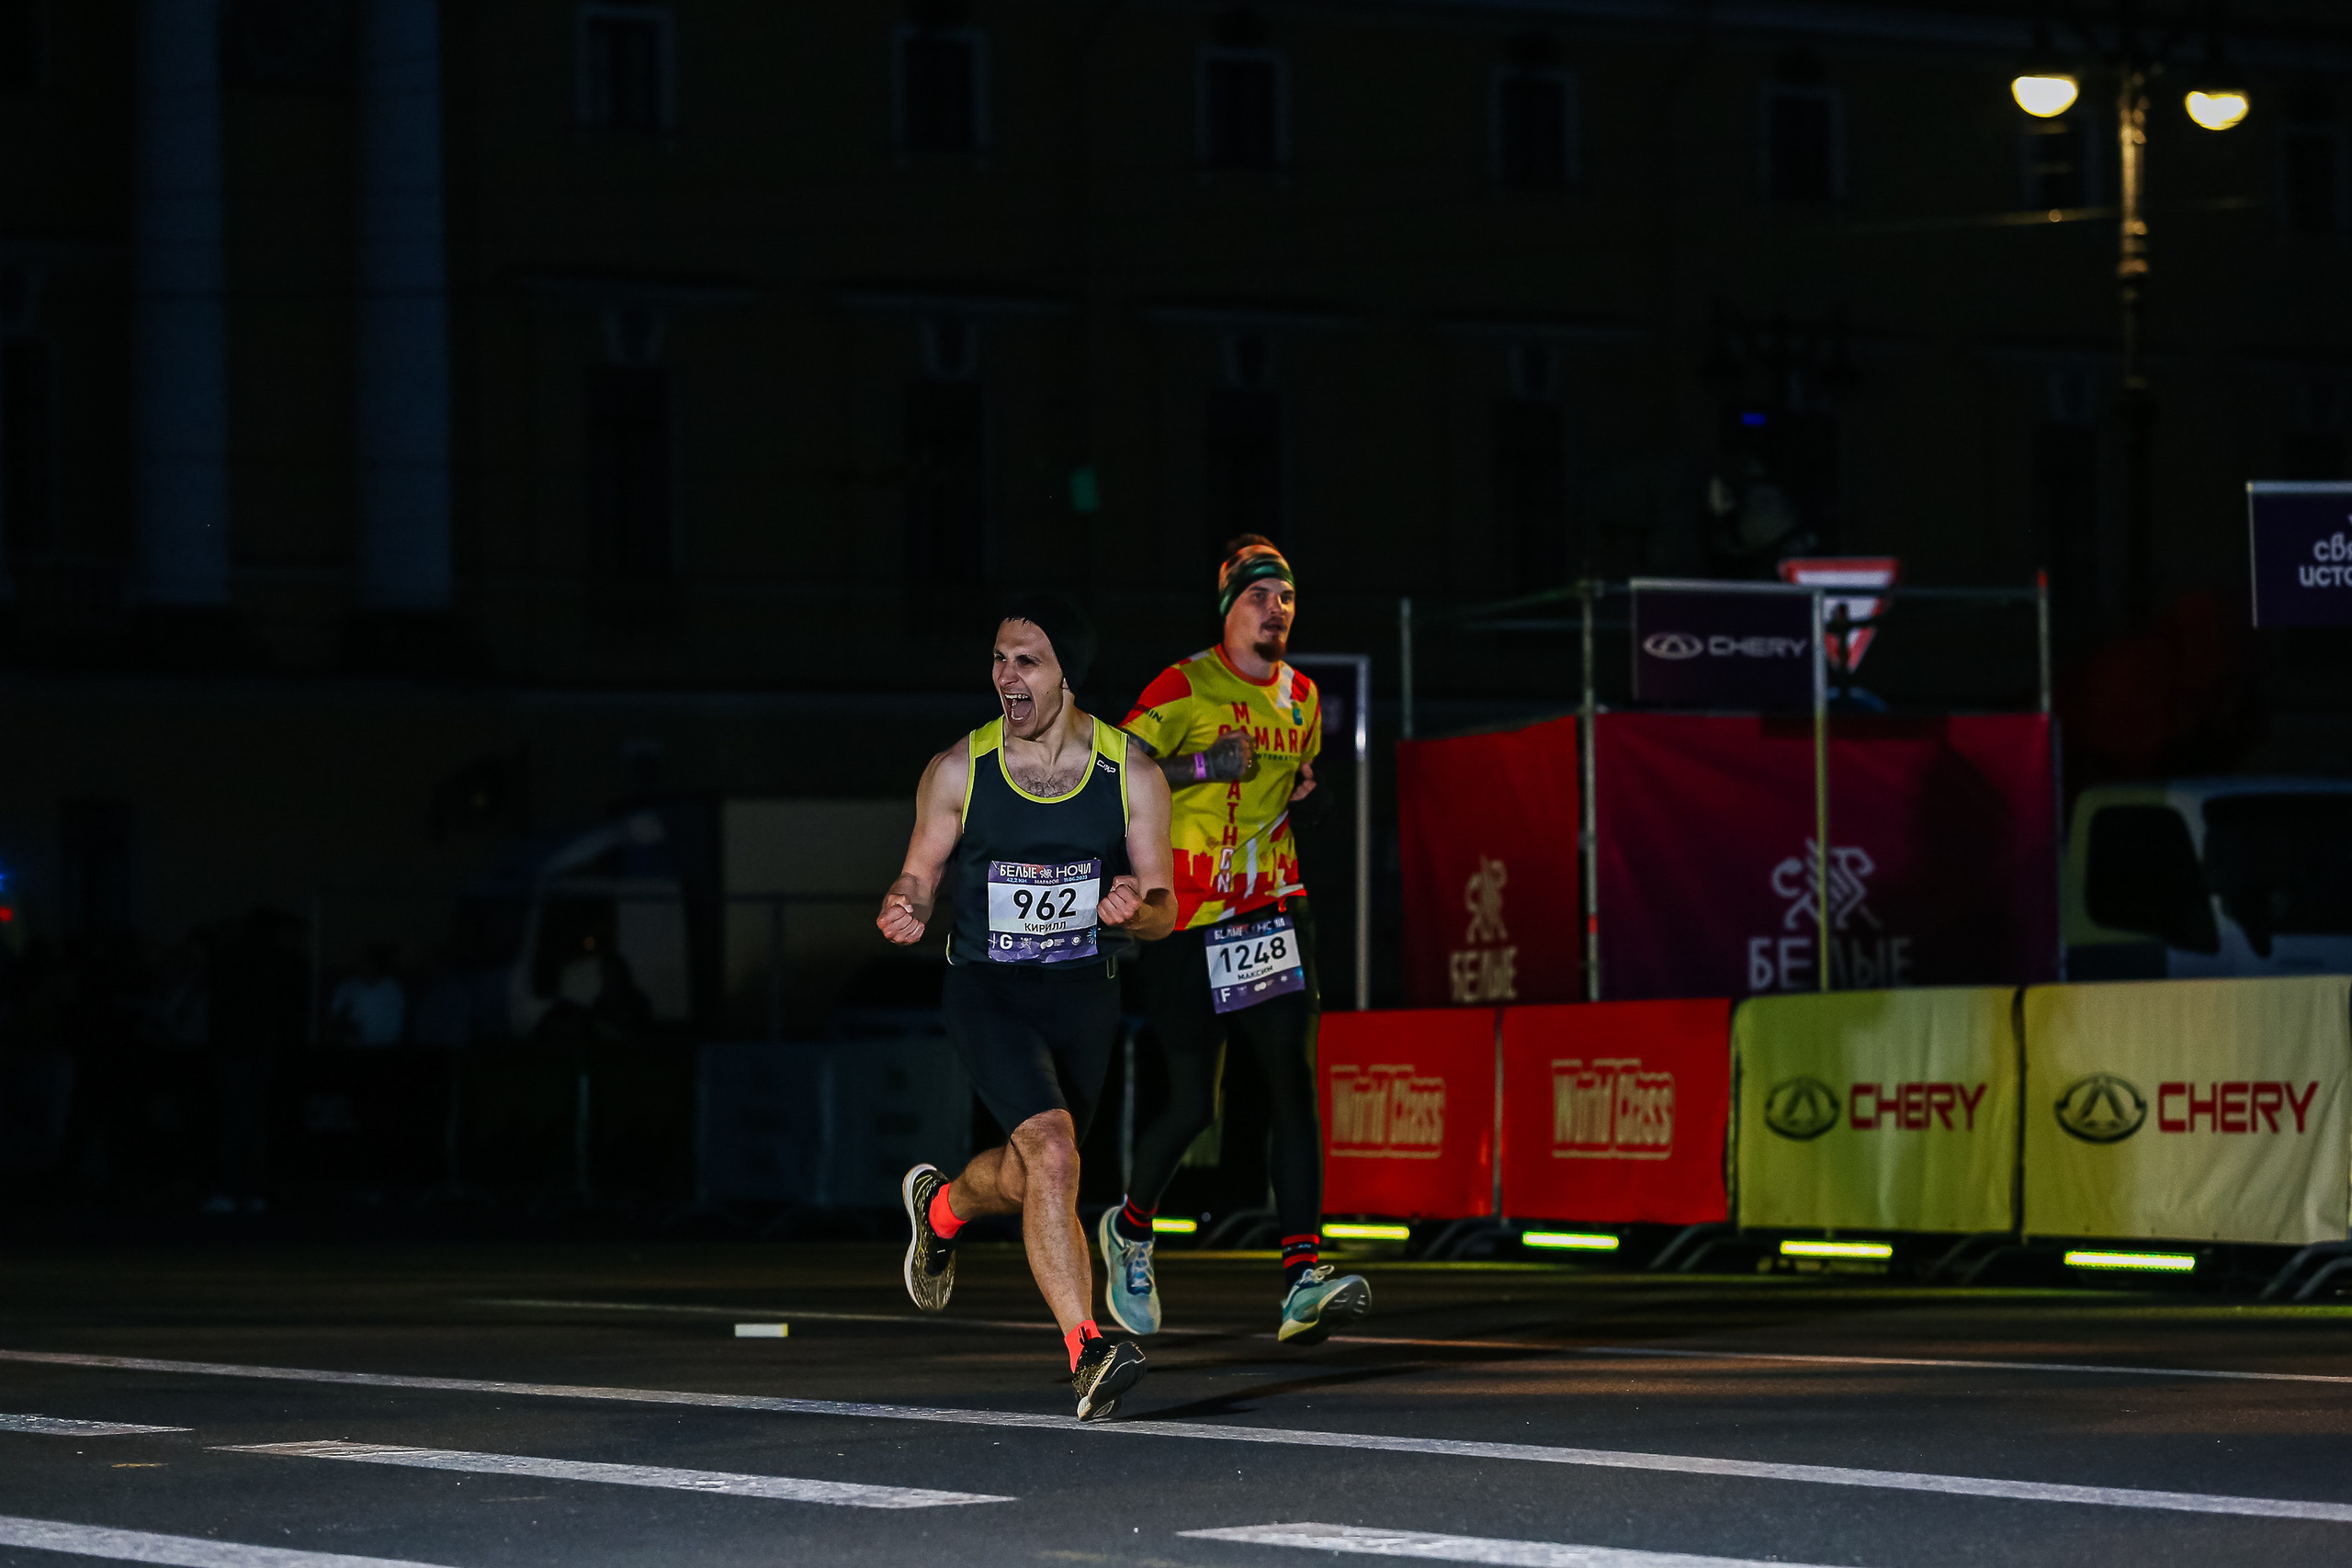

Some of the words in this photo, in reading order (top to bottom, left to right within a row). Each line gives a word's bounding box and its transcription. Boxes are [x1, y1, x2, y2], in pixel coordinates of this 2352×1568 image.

[1707, 635, 1807, 659] CHERY
[1000, 864, 1037, 879] БЕЛЫЕ
[1056, 863, 1091, 878] НОЧИ
[1013, 887, 1077, 920] 962
[1024, 920, 1067, 934] КИРИЛЛ
[1000, 934, 1013, 950] G
[1220, 936, 1287, 973] 1248
[1237, 964, 1274, 981] МАКСИМ
[1448, 945, 1520, 1004] БЕЛЫЕ
[1747, 935, 1914, 992] БЕЛЫЕ
[1220, 987, 1231, 1003] F
[1849, 1082, 1987, 1132] CHERY
[2156, 1080, 2320, 1134] CHERY
